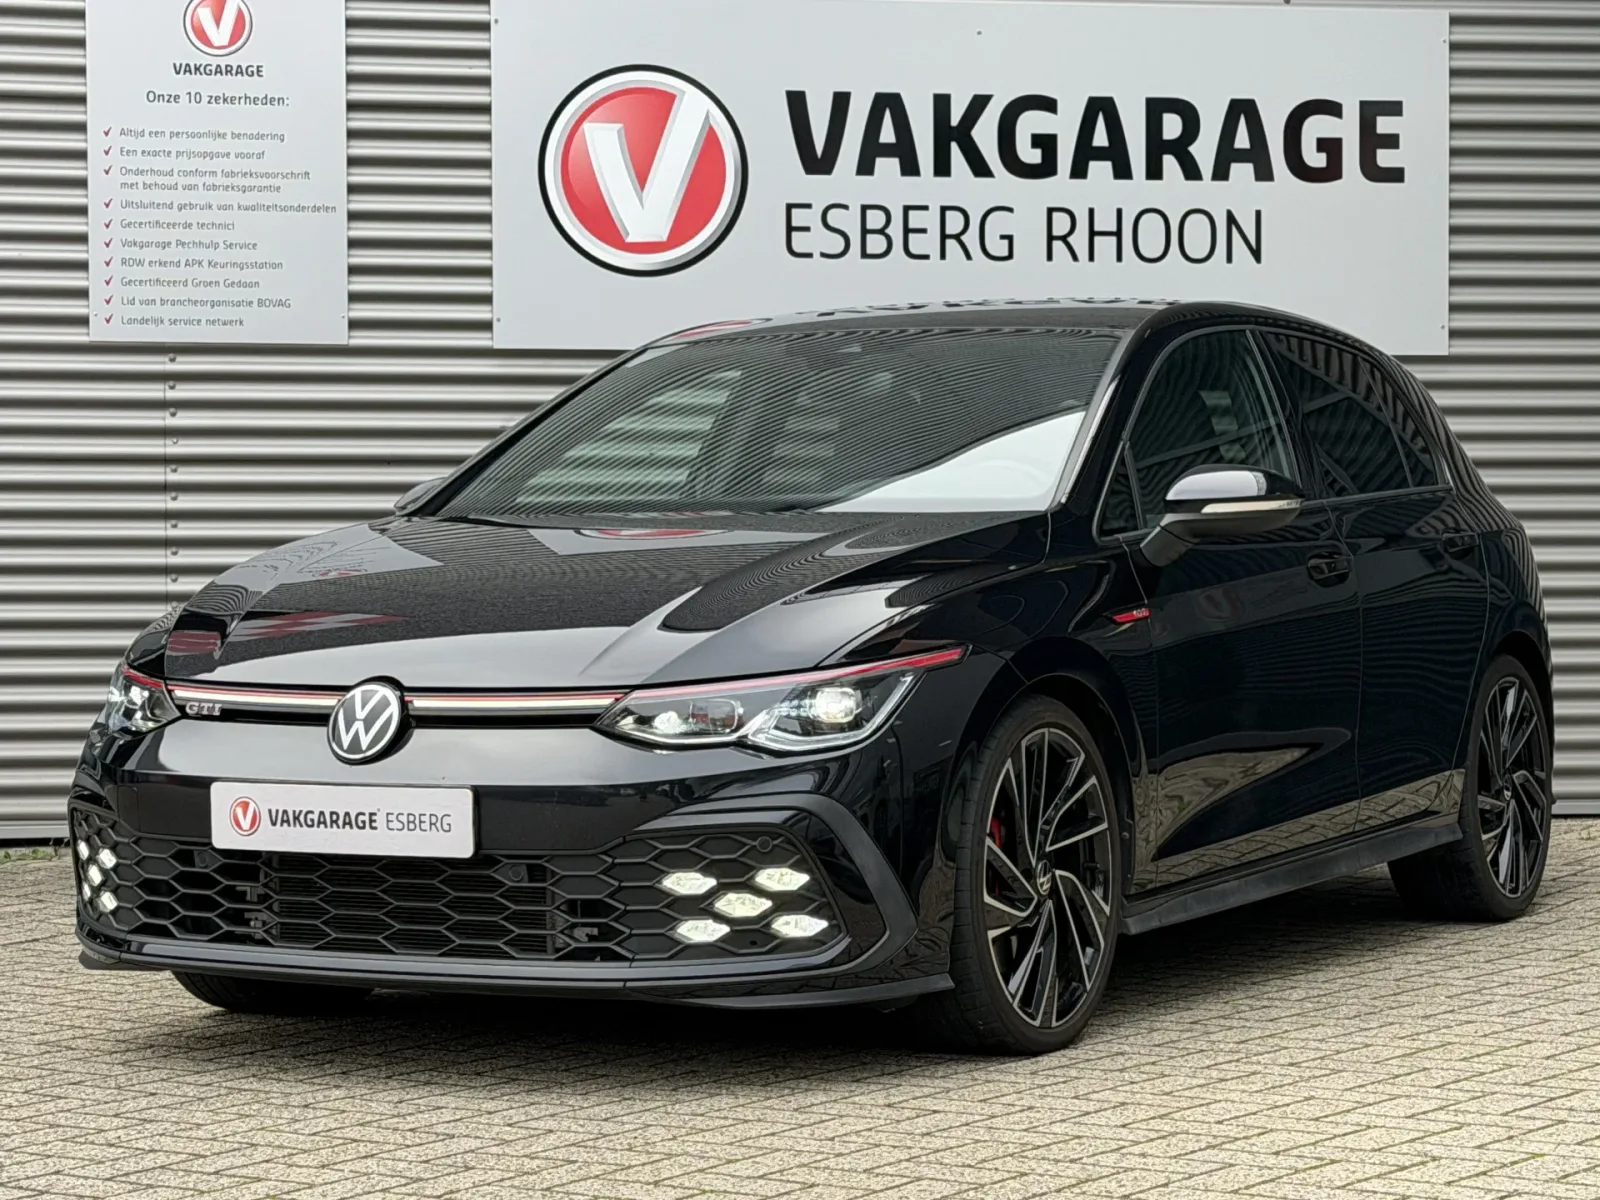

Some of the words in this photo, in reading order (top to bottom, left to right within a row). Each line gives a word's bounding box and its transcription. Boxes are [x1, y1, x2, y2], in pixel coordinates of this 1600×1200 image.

[173, 62, 264, 78] VAKGARAGE
[146, 90, 180, 104] Onze
[186, 91, 202, 104] 10
[207, 92, 289, 106] zekerheden:
[119, 128, 145, 140] Altijd
[148, 130, 165, 139] een
[170, 130, 227, 141] persoonlijke
[231, 131, 285, 143] benadering
[785, 90, 1405, 184] VAKGARAGE
[120, 147, 137, 157] Een
[141, 149, 172, 158] exacte
[176, 149, 231, 160] prijsopgave
[235, 150, 265, 159] vooraf
[120, 166, 174, 177] Onderhoud
[177, 168, 218, 178] conform
[221, 169, 311, 180] fabrieksvoorschrift
[120, 181, 139, 190] met
[142, 180, 178, 190] behoud
[181, 183, 199, 192] van
[202, 182, 281, 194] fabrieksgarantie
[121, 199, 173, 210] Uitsluitend
[177, 201, 213, 212] gebruik
[217, 203, 234, 212] van
[237, 202, 336, 213] kwaliteitsonderdelen
[120, 219, 193, 230] Gecertificeerde
[197, 221, 236, 230] technici
[785, 202, 1014, 262] ESBERG
[1046, 206, 1263, 265] RHOON
[120, 238, 172, 250] Vakgarage
[176, 239, 219, 251] Pechhulp
[223, 240, 257, 250] Service
[121, 257, 145, 267] RDW
[148, 258, 181, 268] erkend
[184, 258, 204, 268] APK
[208, 259, 283, 271] Keuringsstation
[121, 277, 188, 287] Gecertificeerd
[191, 278, 220, 288] Groen
[223, 278, 259, 288] Gedaan
[121, 296, 135, 306] Lid
[139, 298, 156, 307] van
[160, 297, 254, 309] brancheorganisatie
[257, 298, 291, 308] BOVAG
[121, 315, 164, 327] Landelijk
[168, 317, 202, 326] service
[206, 318, 244, 326] netwerk
[185, 702, 222, 716] GTI
[268, 808, 378, 830] VAKGARAGE
[386, 812, 452, 833] ESBERG
